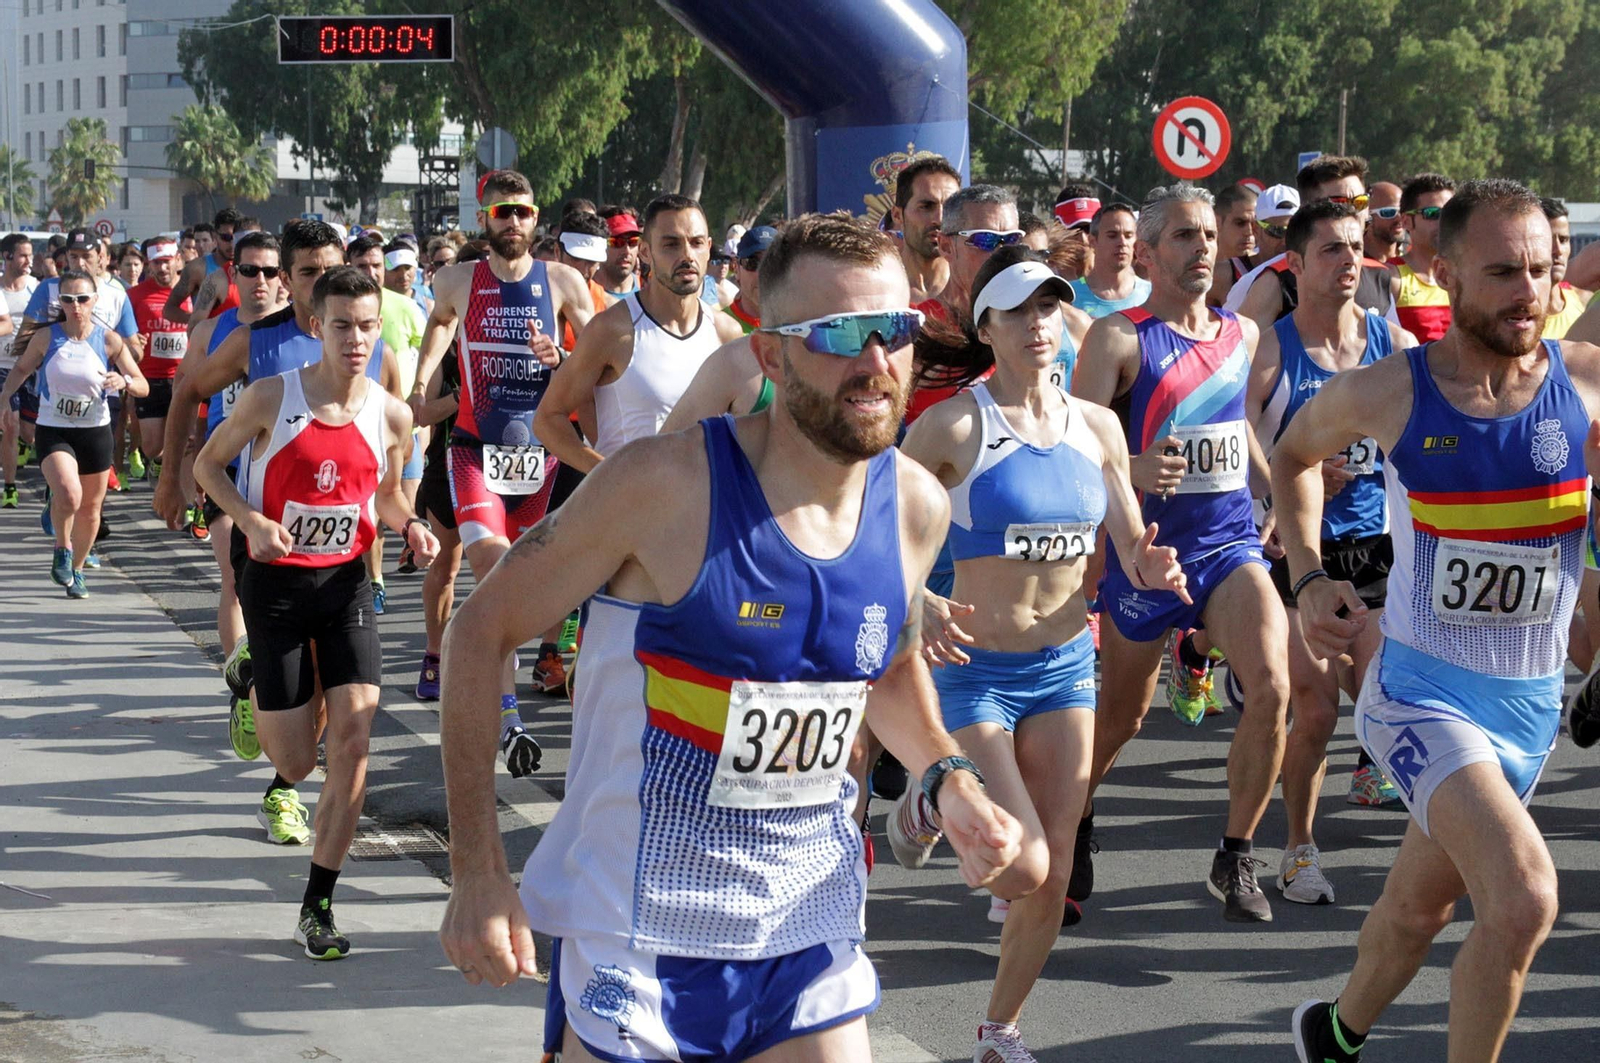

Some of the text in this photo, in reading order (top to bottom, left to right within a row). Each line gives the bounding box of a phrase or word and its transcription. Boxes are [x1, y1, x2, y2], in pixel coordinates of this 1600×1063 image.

[320, 26, 433, 53] 0:00:04
[486, 306, 538, 317] OURENSE
[154, 337, 182, 351] 4046
[483, 328, 532, 340] TRIATLO
[481, 356, 543, 381] RODRIGUEZ
[56, 398, 93, 417] 4047
[489, 455, 539, 480] 3242
[1181, 435, 1240, 475] 4048
[288, 516, 353, 546] 4293
[1442, 558, 1546, 613] 3201
[1119, 602, 1138, 619] Viso
[732, 707, 852, 774] 3203
